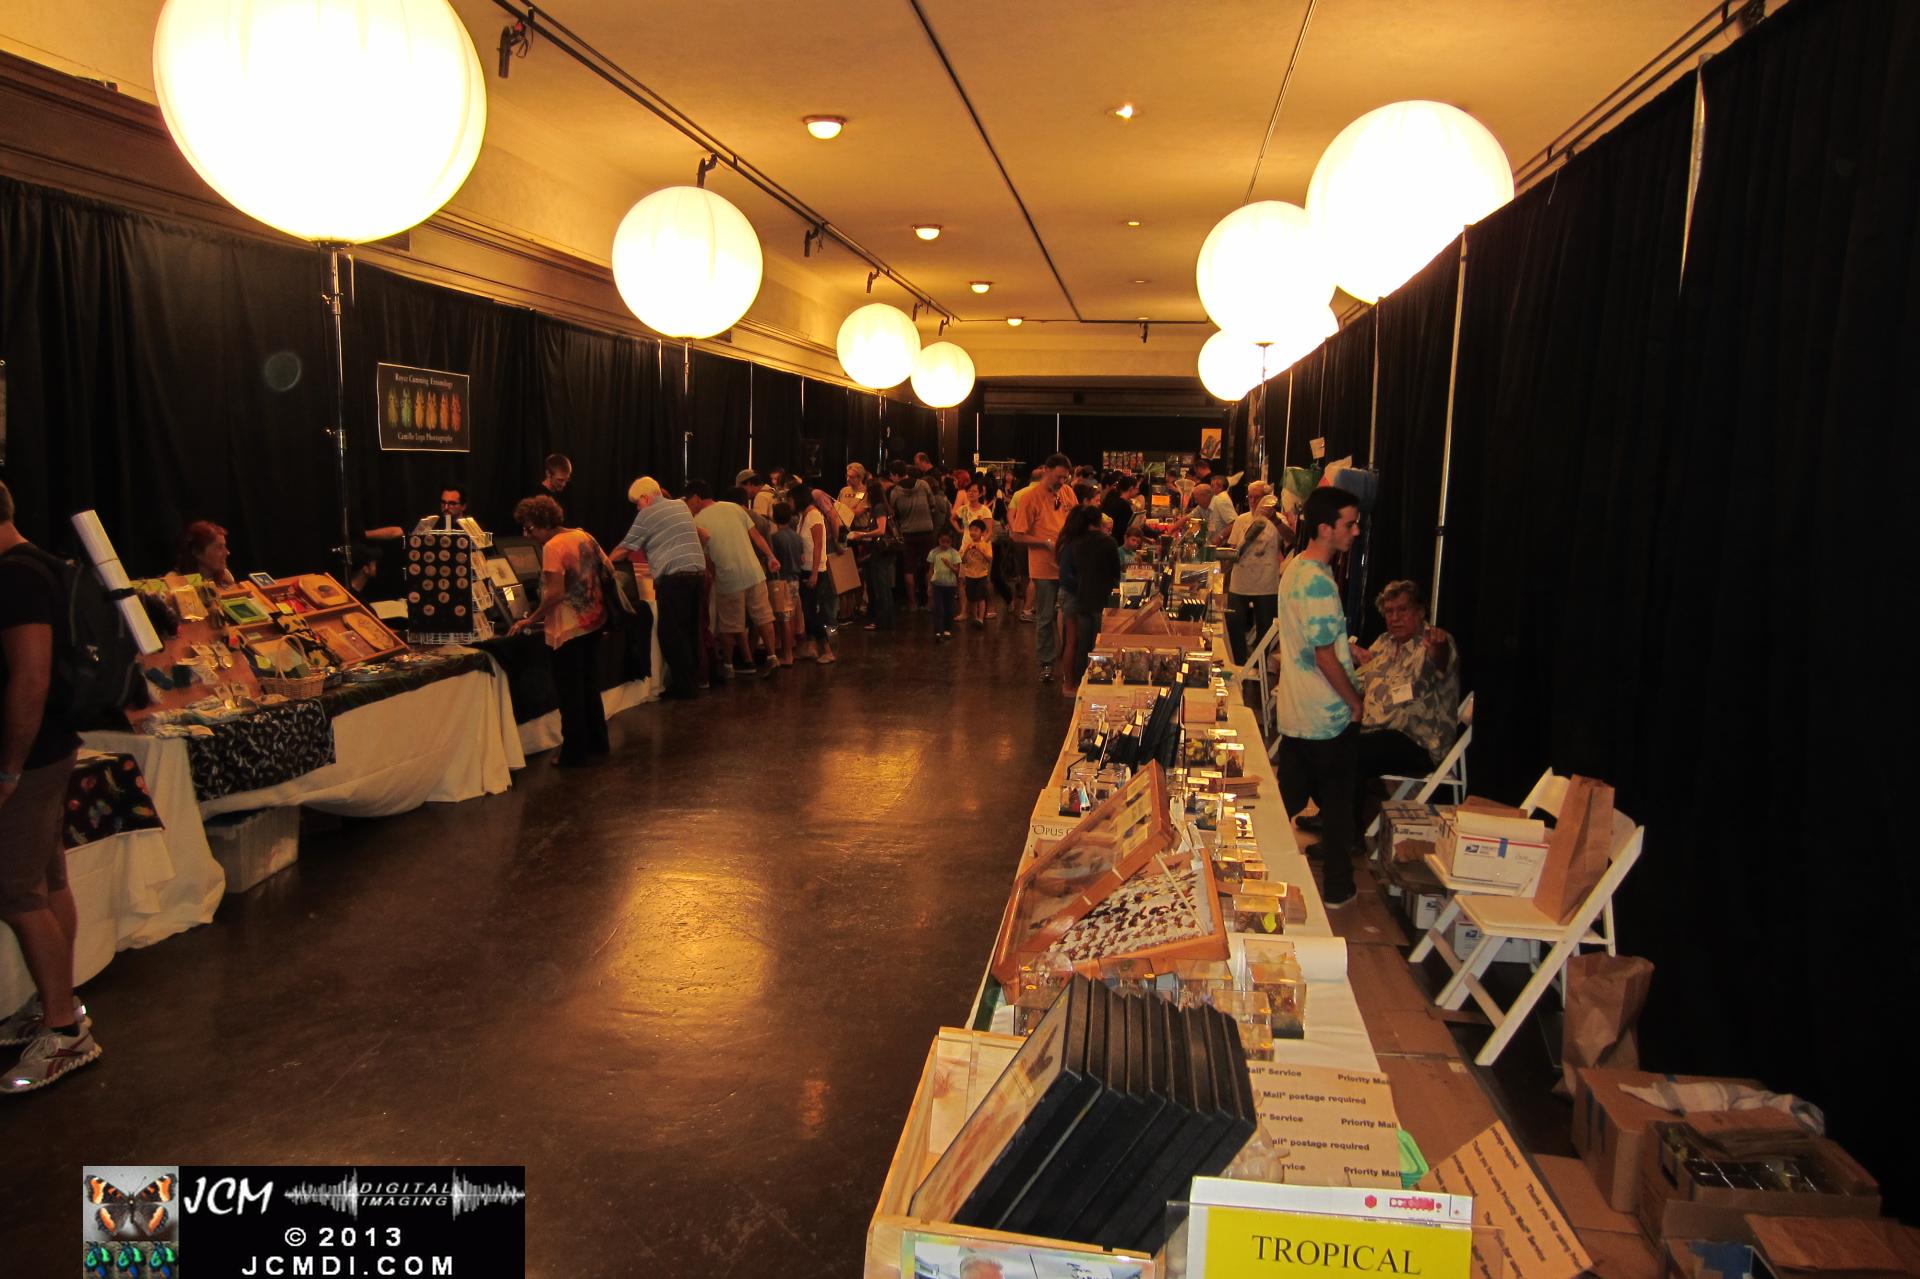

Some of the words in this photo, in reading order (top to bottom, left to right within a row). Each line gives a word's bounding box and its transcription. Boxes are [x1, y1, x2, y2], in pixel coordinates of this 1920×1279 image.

[1268, 1068, 1302, 1077] Service
[1337, 1074, 1370, 1084] Priority
[1289, 1093, 1325, 1102] postage
[1328, 1096, 1367, 1105] required
[1270, 1113, 1304, 1123] Service
[1341, 1118, 1375, 1129] Priority
[1377, 1121, 1397, 1129] Mail
[1290, 1140, 1327, 1149] postage
[1330, 1142, 1370, 1151] required
[1343, 1166, 1378, 1177] Priority
[1251, 1235, 1421, 1275] TROPICAL
